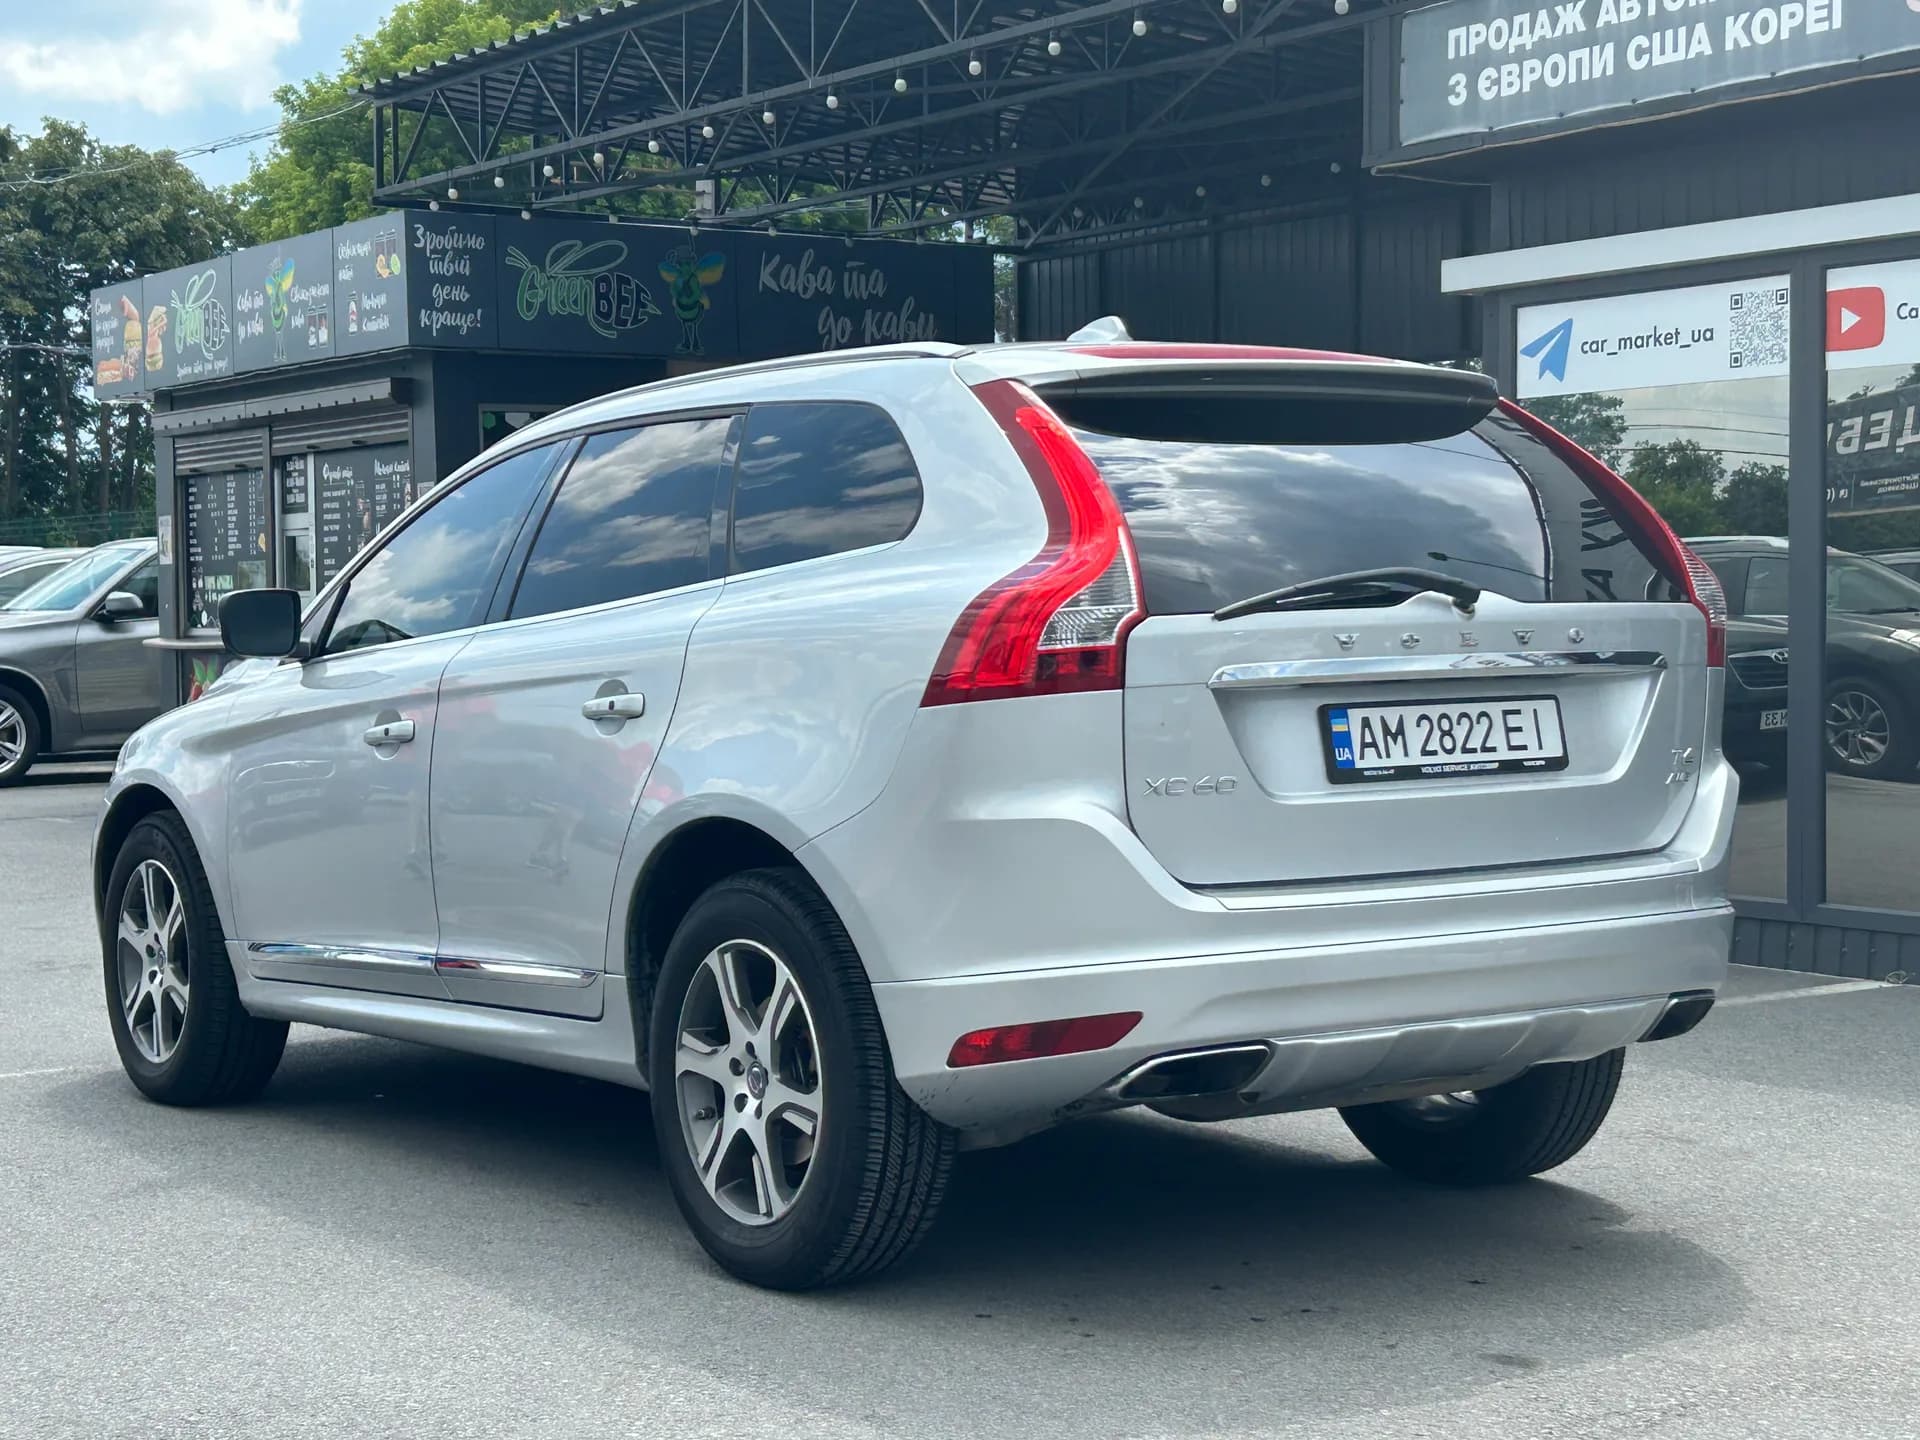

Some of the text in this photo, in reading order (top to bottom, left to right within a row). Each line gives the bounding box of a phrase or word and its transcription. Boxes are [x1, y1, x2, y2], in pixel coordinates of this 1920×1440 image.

[1447, 0, 1587, 59] ПРОДАЖ
[1447, 72, 1468, 106] З
[1478, 42, 1614, 100] ЄВРОПИ
[1626, 22, 1713, 72] США
[414, 223, 485, 257] Зробимо
[429, 251, 471, 276] твій
[758, 248, 888, 300] Кава та
[432, 283, 471, 308] день
[419, 308, 483, 337] краще!
[817, 296, 938, 350] до кави
[1579, 324, 1714, 358] car_market_ua
[1333, 627, 1586, 649] VOLVO
[1334, 707, 1545, 762] UA AM 2822 EI
[1143, 775, 1238, 797] XC60
